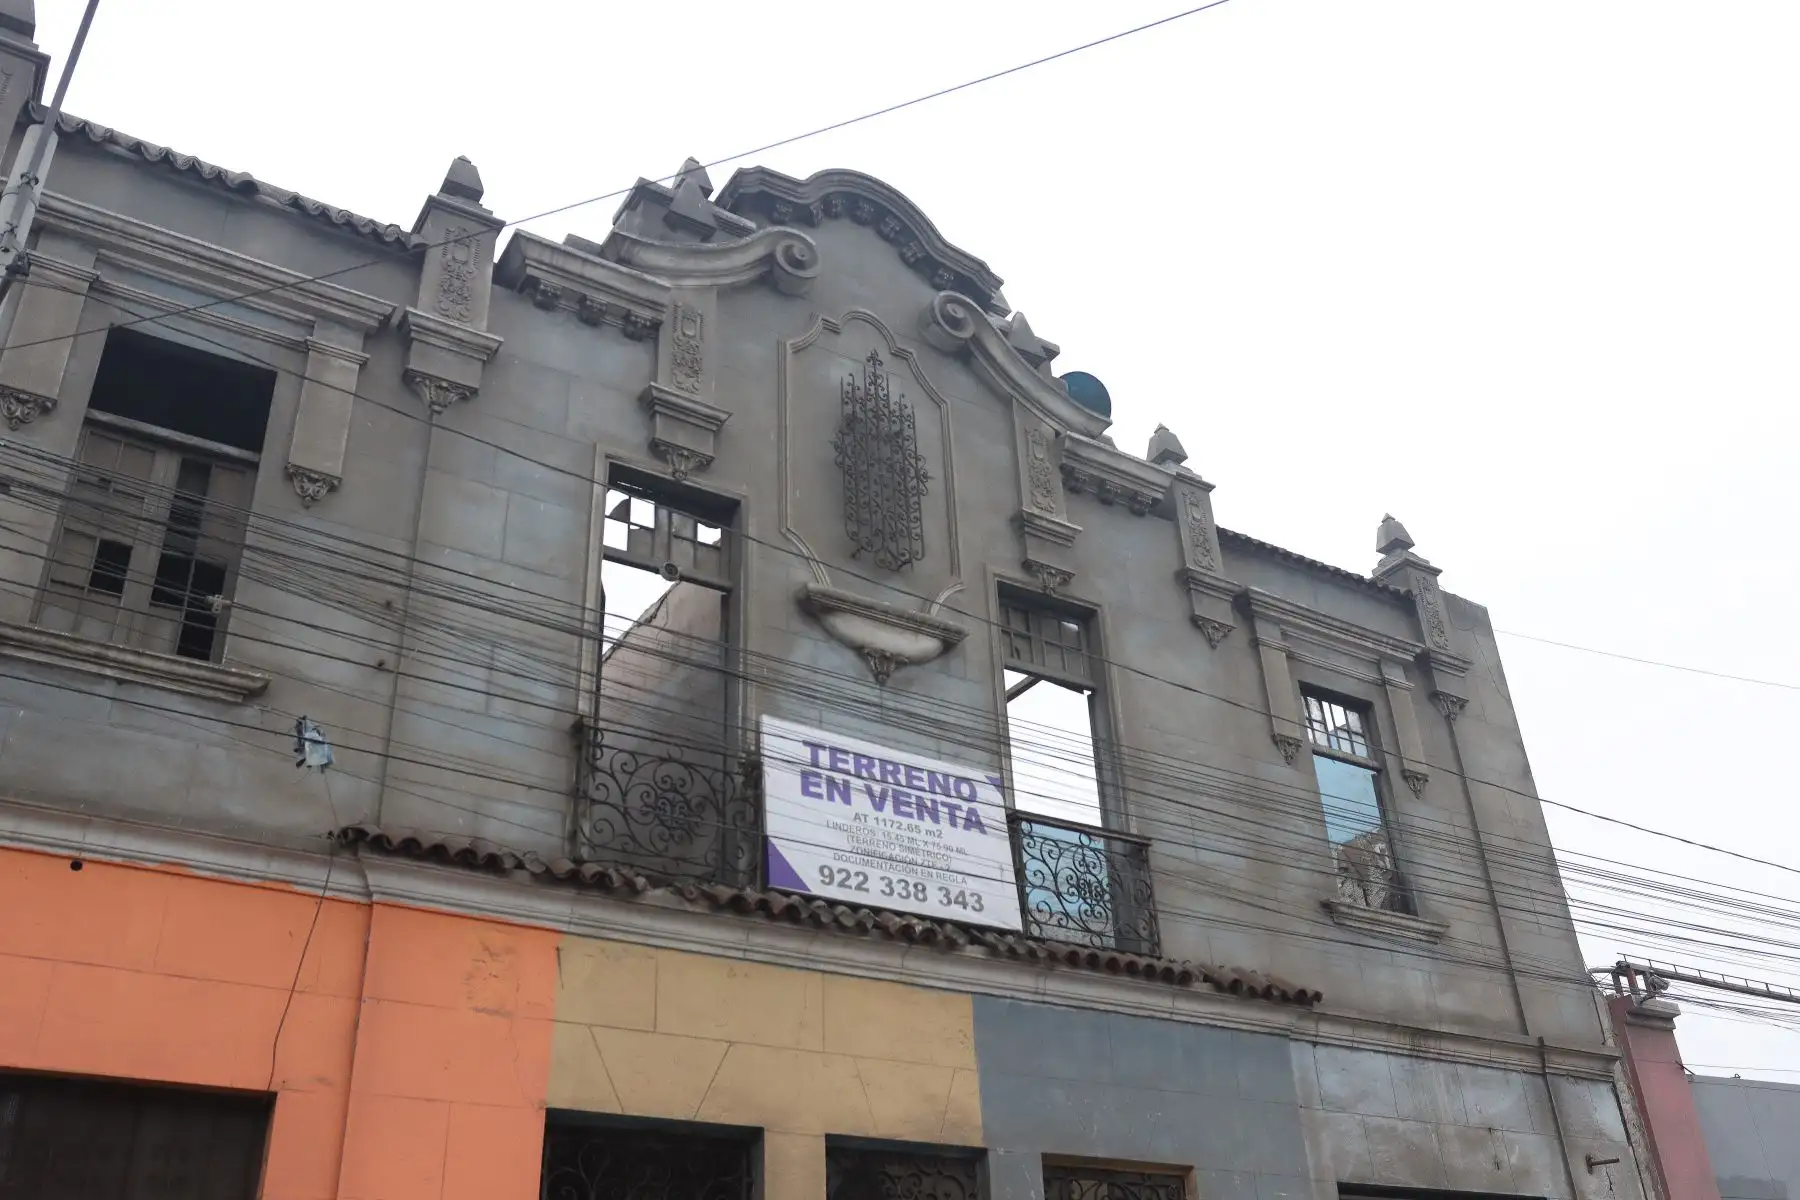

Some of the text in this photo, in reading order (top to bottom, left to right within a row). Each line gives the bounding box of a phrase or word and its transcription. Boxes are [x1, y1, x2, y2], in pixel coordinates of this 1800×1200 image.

[802, 739, 978, 803] TERRENO
[800, 769, 988, 835] EN VENTA
[853, 811, 943, 840] AT 1172.65 m2
[818, 864, 985, 912] 922 338 343
